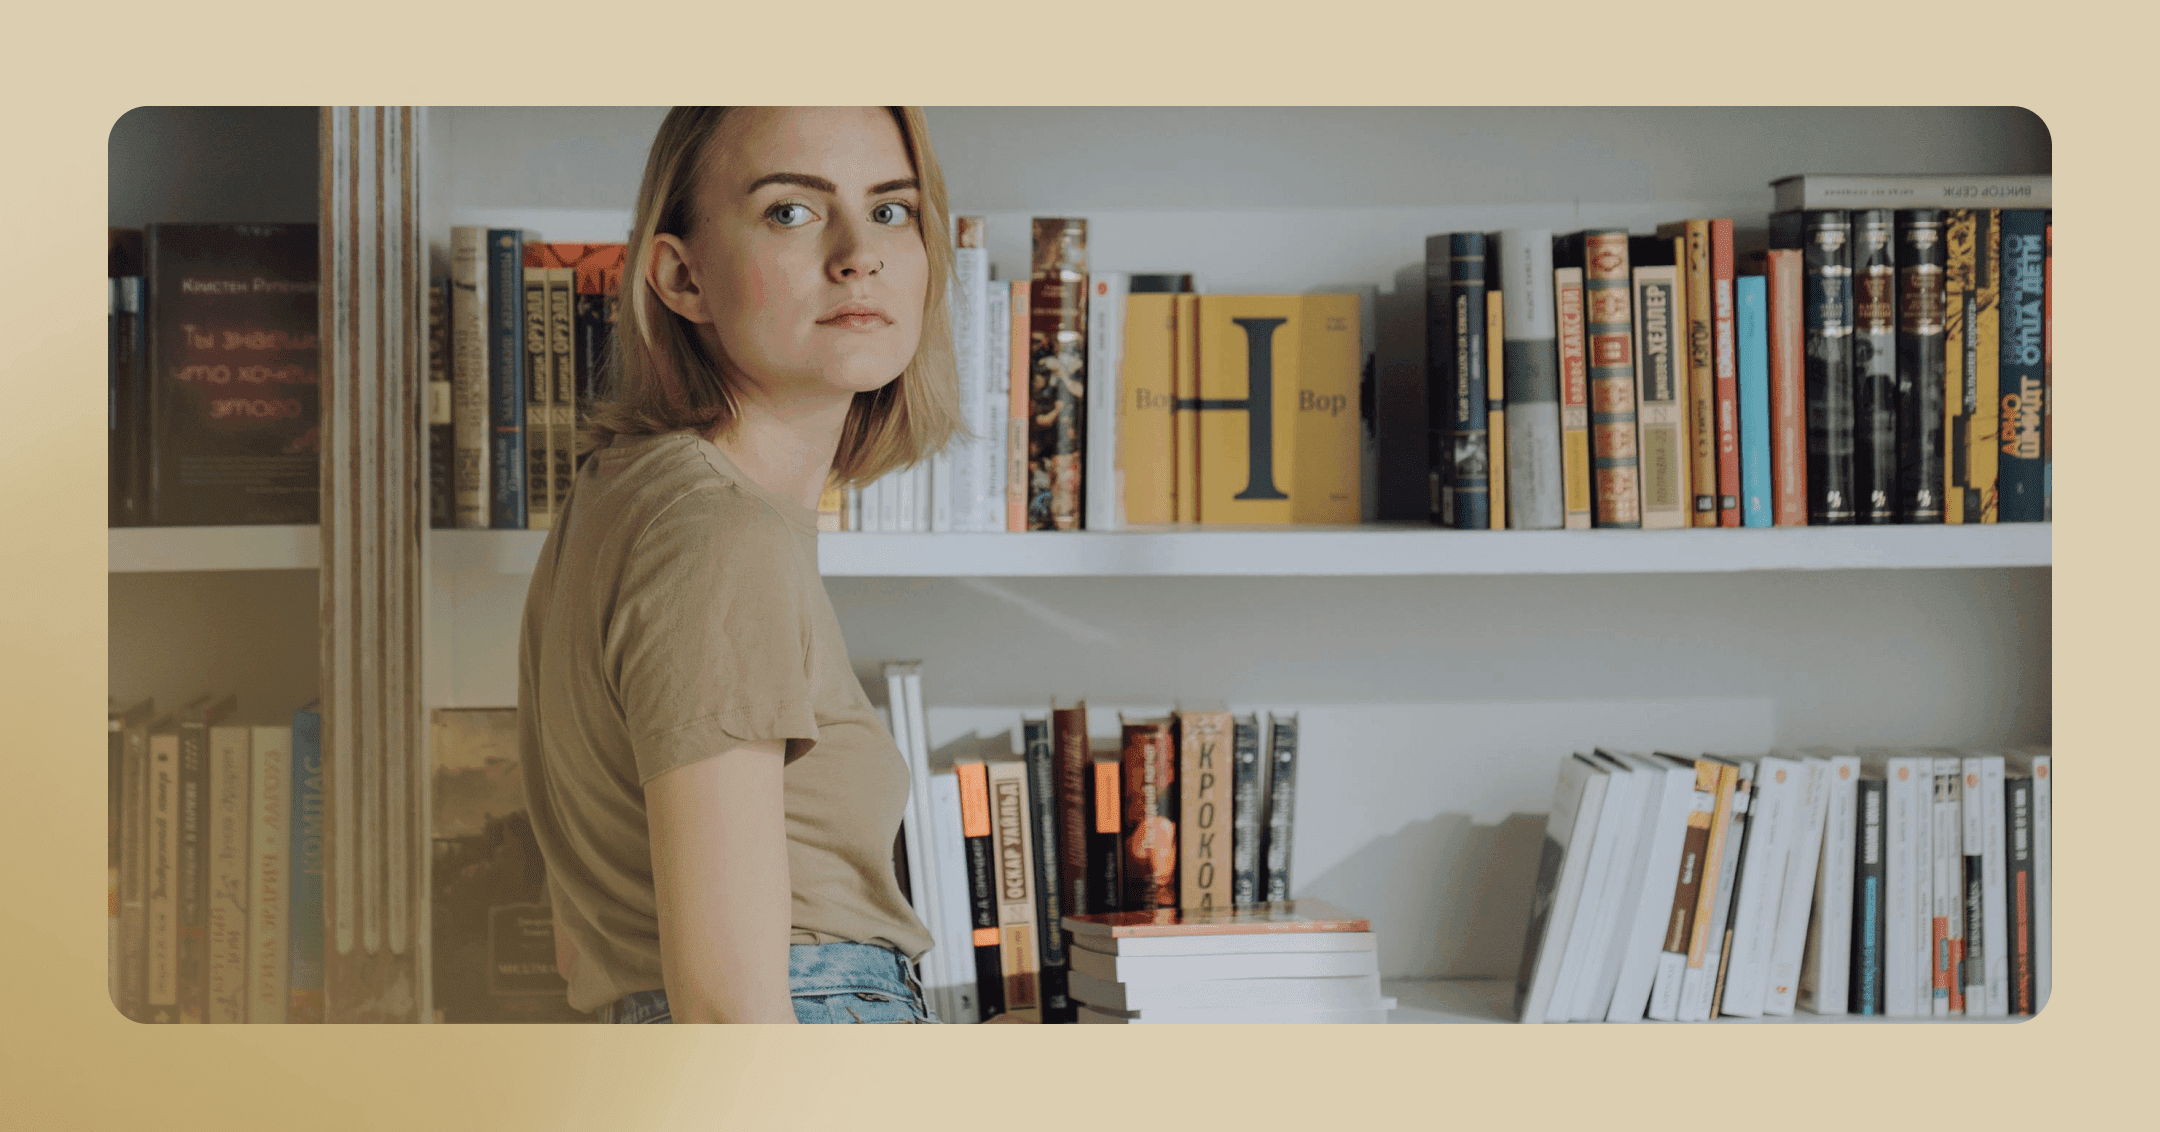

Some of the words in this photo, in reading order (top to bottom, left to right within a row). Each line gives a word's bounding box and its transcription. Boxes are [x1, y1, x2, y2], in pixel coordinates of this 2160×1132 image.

[1943, 185, 1978, 198] СЕРЖ
[1982, 185, 2032, 198] ВИКТОР
[2021, 234, 2044, 295] ДЕТИ
[527, 290, 546, 354] ОРУЭЛЛ
[552, 290, 571, 354] ОРУЭЛЛ
[1562, 288, 1583, 359] ХАКСЛИ
[1646, 284, 1668, 356] ХЕЛЛЕР
[2021, 299, 2042, 367] ОТЦА
[1299, 389, 1347, 414] Вор
[2001, 393, 2022, 457] АРНО
[2021, 375, 2043, 459] ШМИДТ
[531, 446, 548, 505] 1984
[555, 446, 572, 503] 1984
[303, 754, 323, 875] КОМПАС
[999, 783, 1022, 846] УАЙЛЬД
[1004, 846, 1025, 899] ОСКАР
